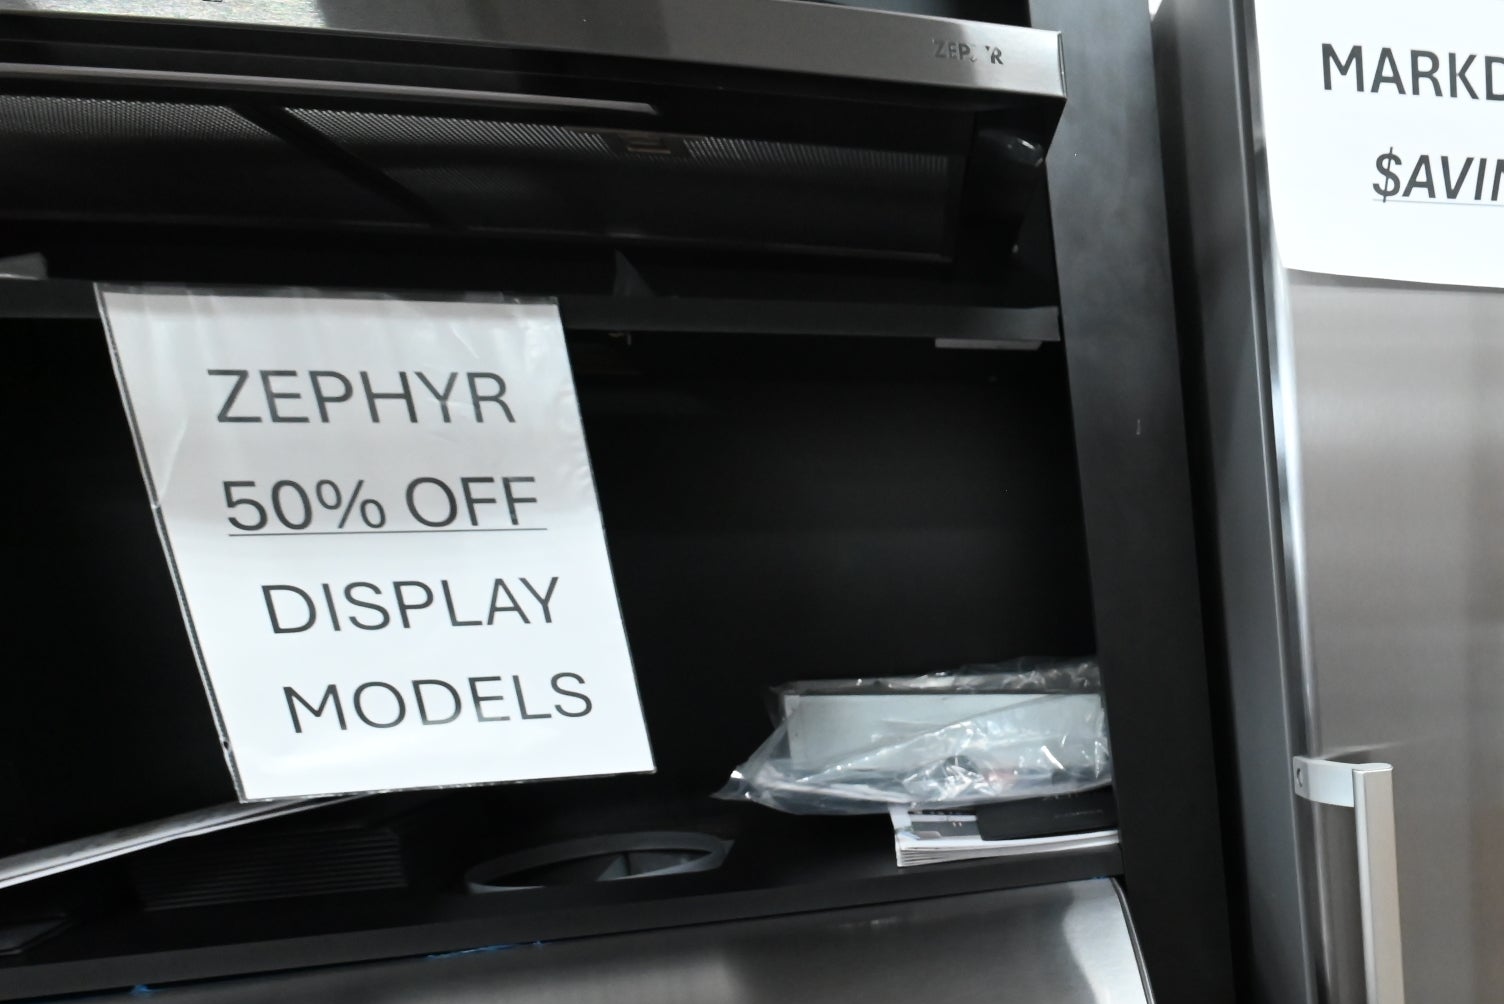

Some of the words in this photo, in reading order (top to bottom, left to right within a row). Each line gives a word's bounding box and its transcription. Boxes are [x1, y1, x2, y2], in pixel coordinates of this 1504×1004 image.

[207, 369, 516, 424] ZEPHYR
[222, 478, 386, 531] 50%
[405, 476, 538, 527] OFF
[261, 576, 560, 634] DISPLAY
[283, 672, 593, 734] MODELS
